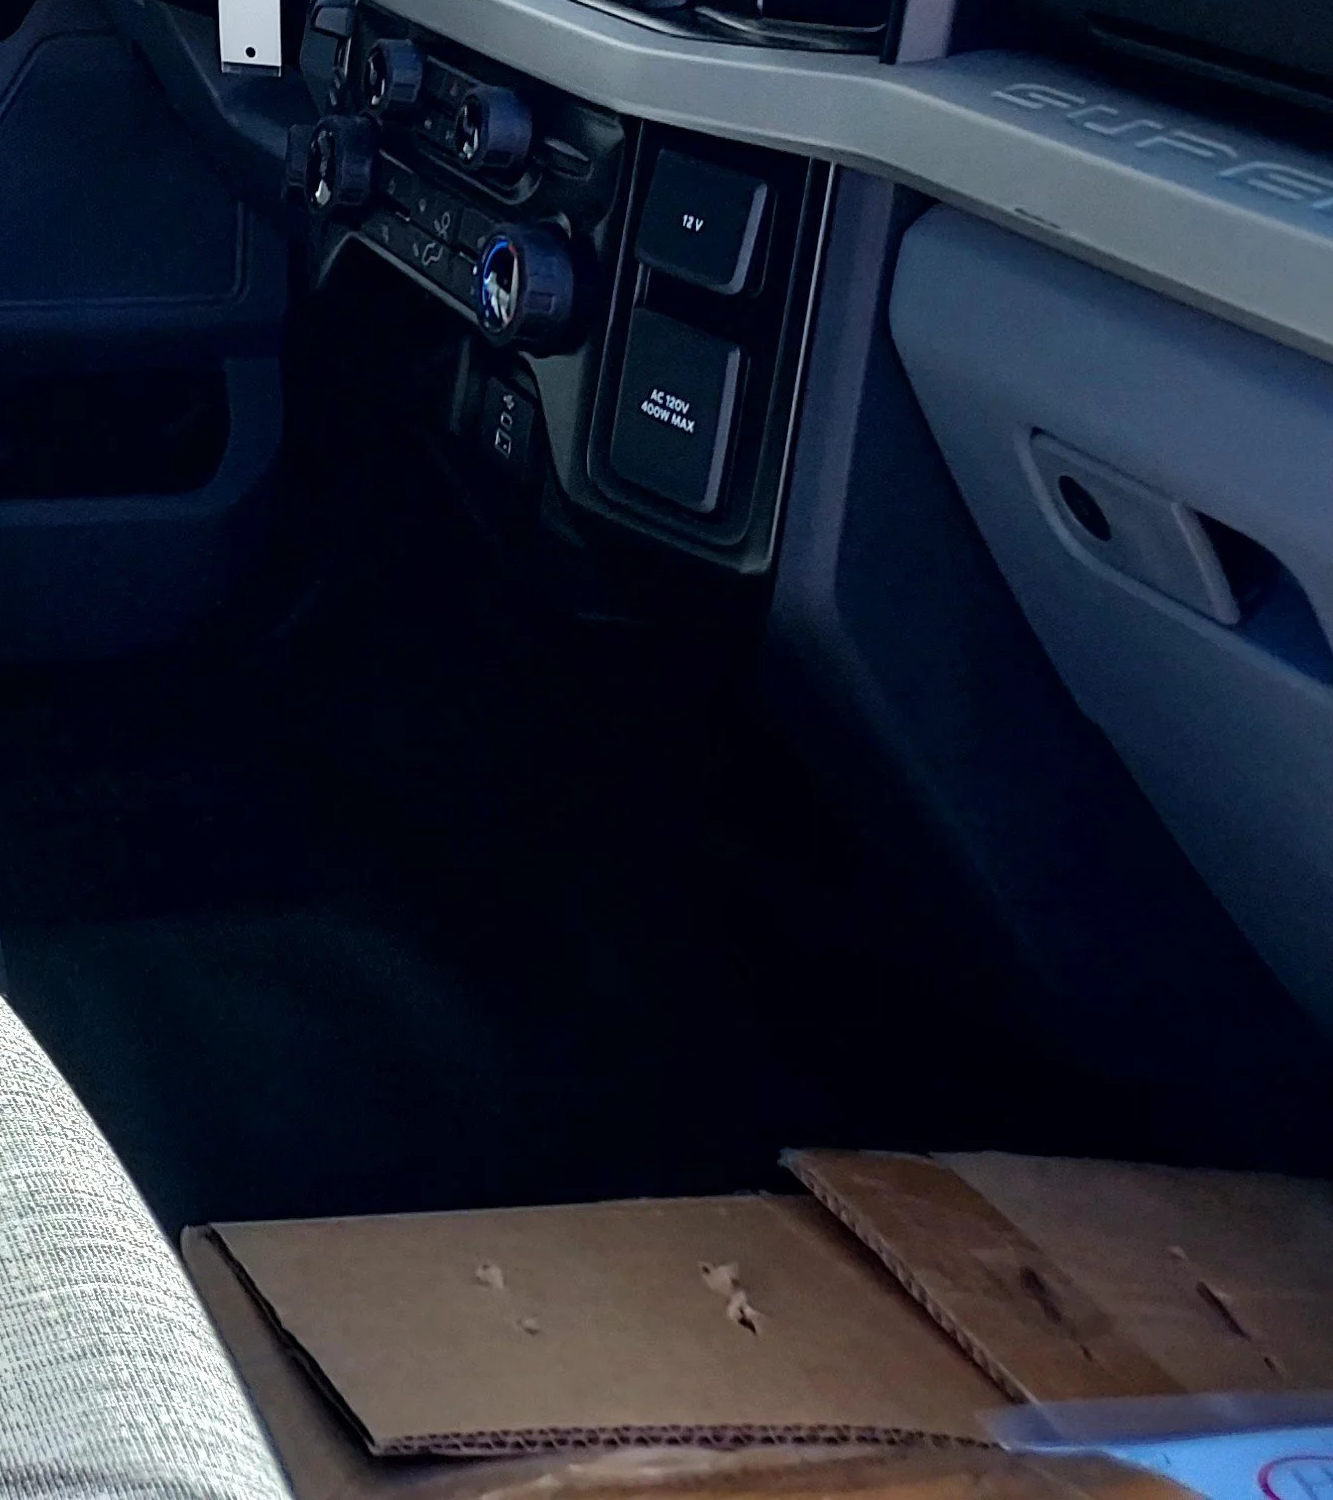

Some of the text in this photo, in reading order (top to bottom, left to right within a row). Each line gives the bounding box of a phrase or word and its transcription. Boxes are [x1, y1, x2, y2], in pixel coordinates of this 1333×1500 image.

[990, 83, 1333, 209] SUPE
[682, 214, 704, 232] 12 V
[640, 400, 696, 434] 400W MAX
[650, 389, 690, 415] AC 120V
